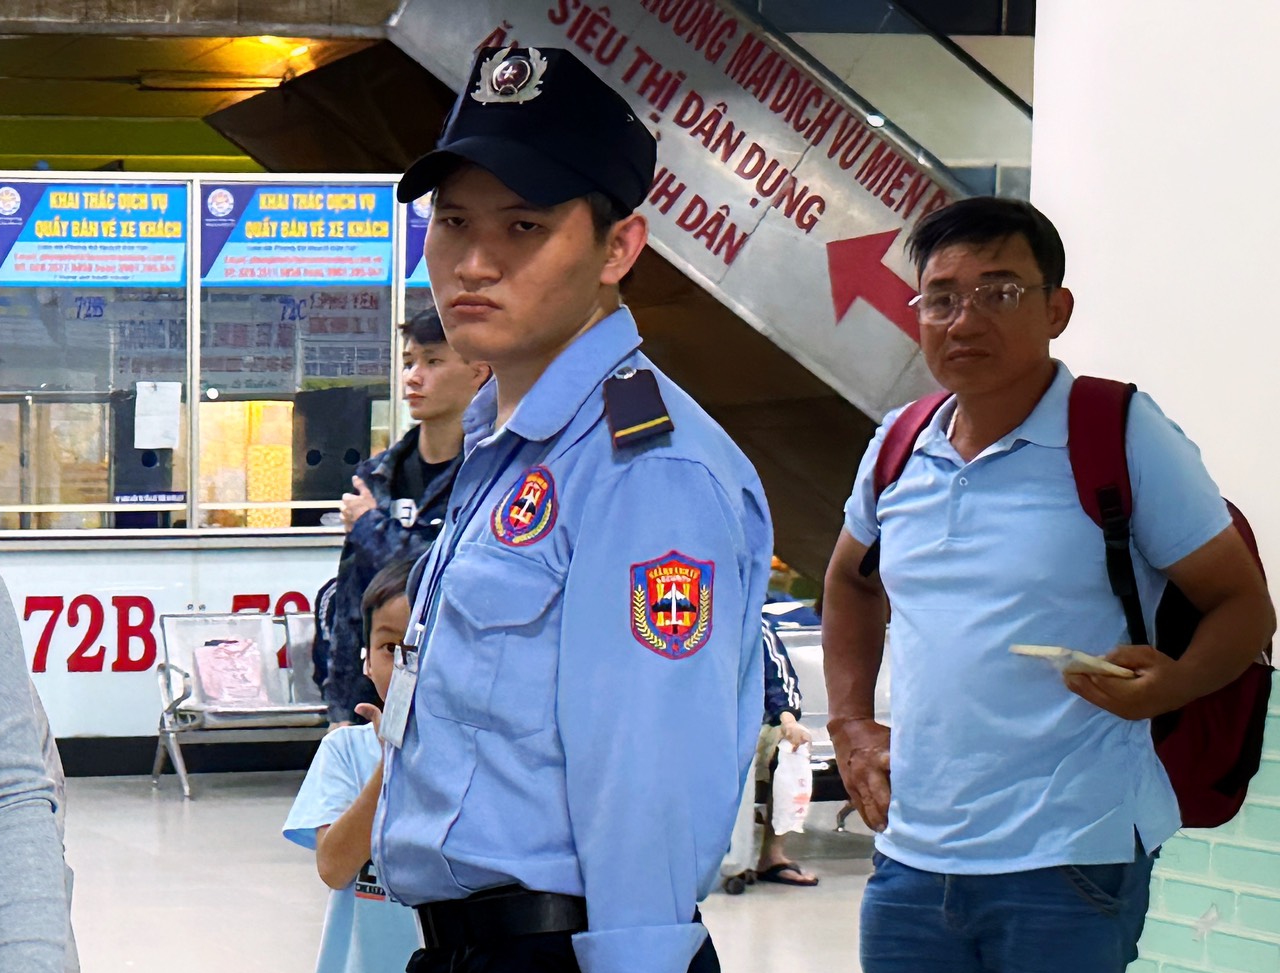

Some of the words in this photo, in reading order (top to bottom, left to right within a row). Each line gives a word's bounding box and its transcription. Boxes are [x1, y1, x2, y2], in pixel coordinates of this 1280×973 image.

[672, 90, 746, 163] DÂN
[734, 142, 826, 234] DỤNG
[676, 194, 749, 265] DÂN
[24, 594, 157, 673] 72B
